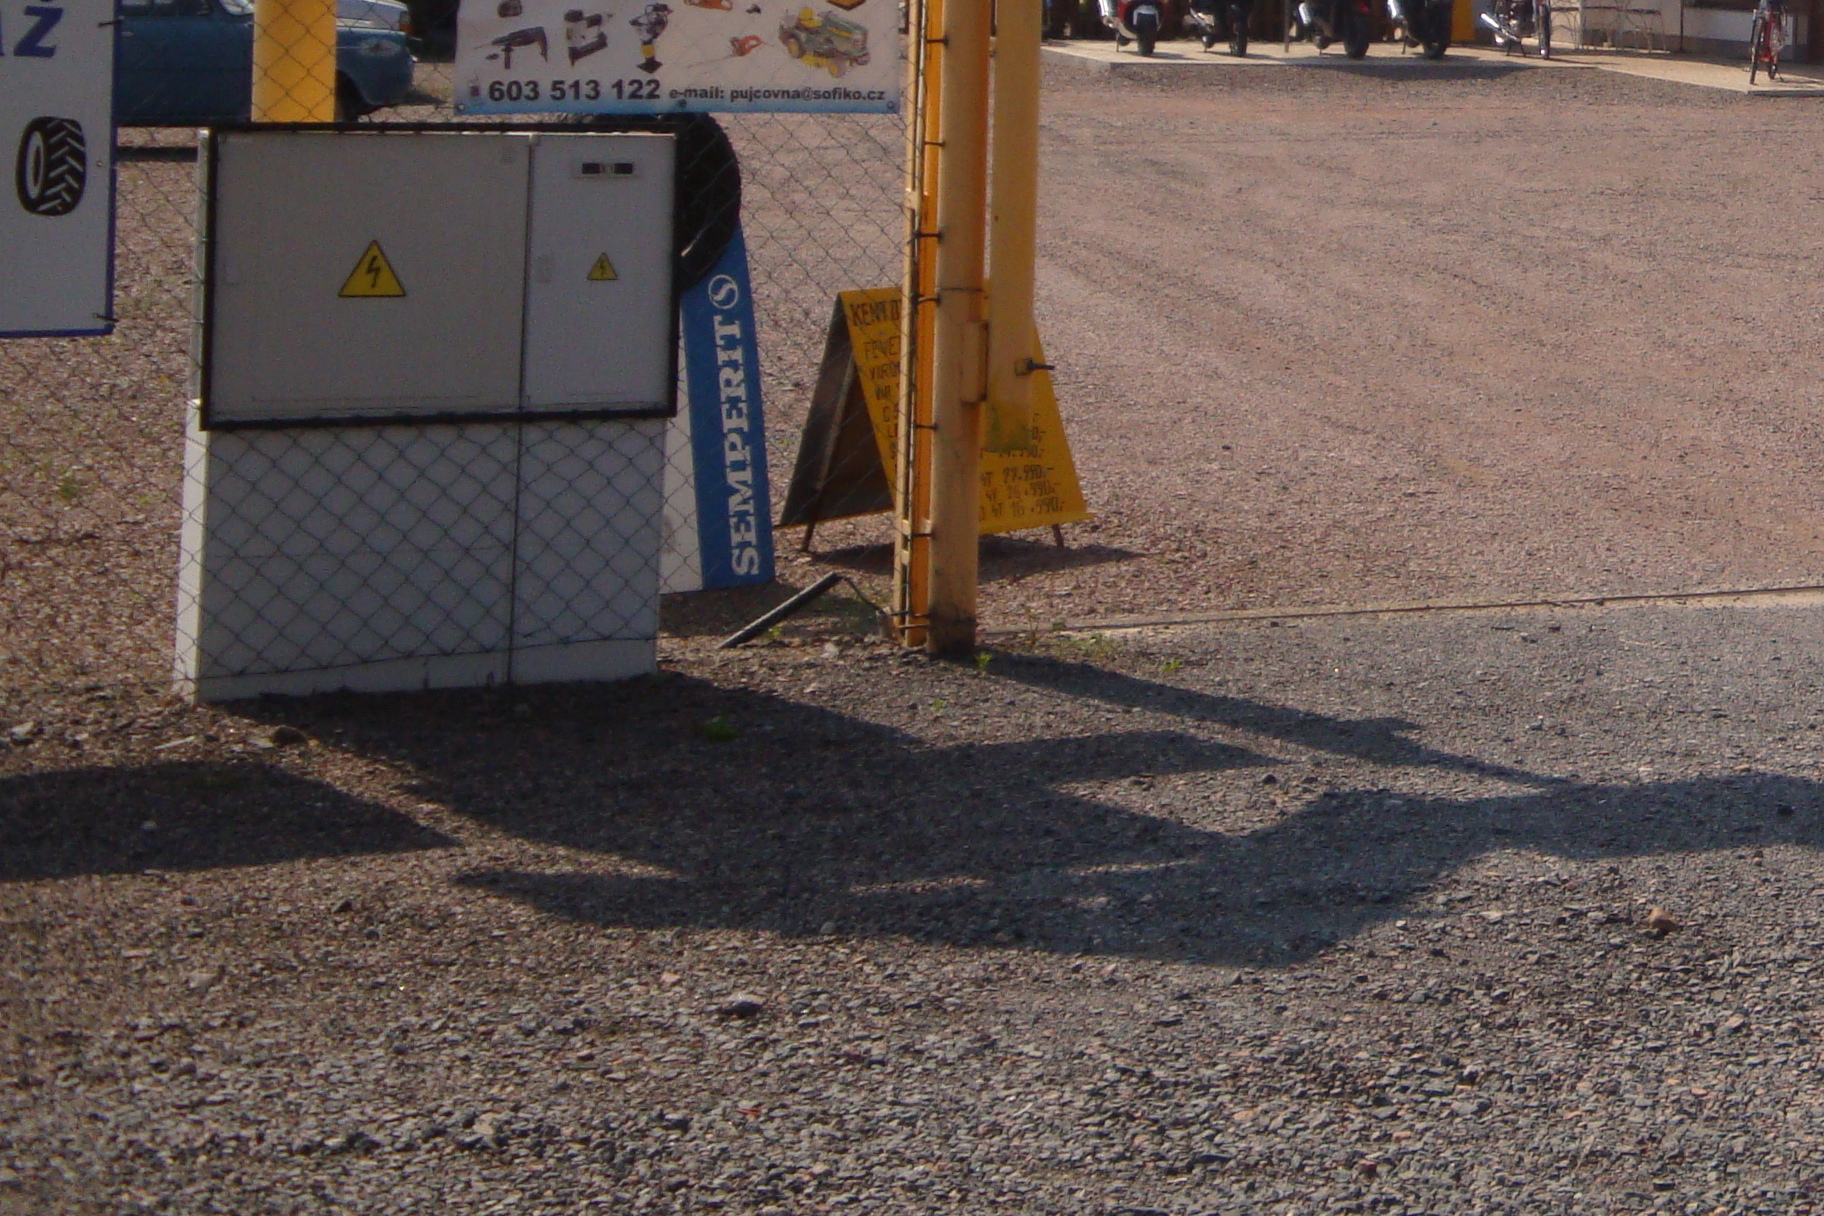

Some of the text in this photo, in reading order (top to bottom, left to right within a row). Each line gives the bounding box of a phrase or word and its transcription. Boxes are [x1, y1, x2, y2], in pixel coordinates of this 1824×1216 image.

[488, 79, 885, 104] 603 513 122 e-mail: pujcovna@sofiko.cz
[714, 315, 760, 577] SEMPERIT
